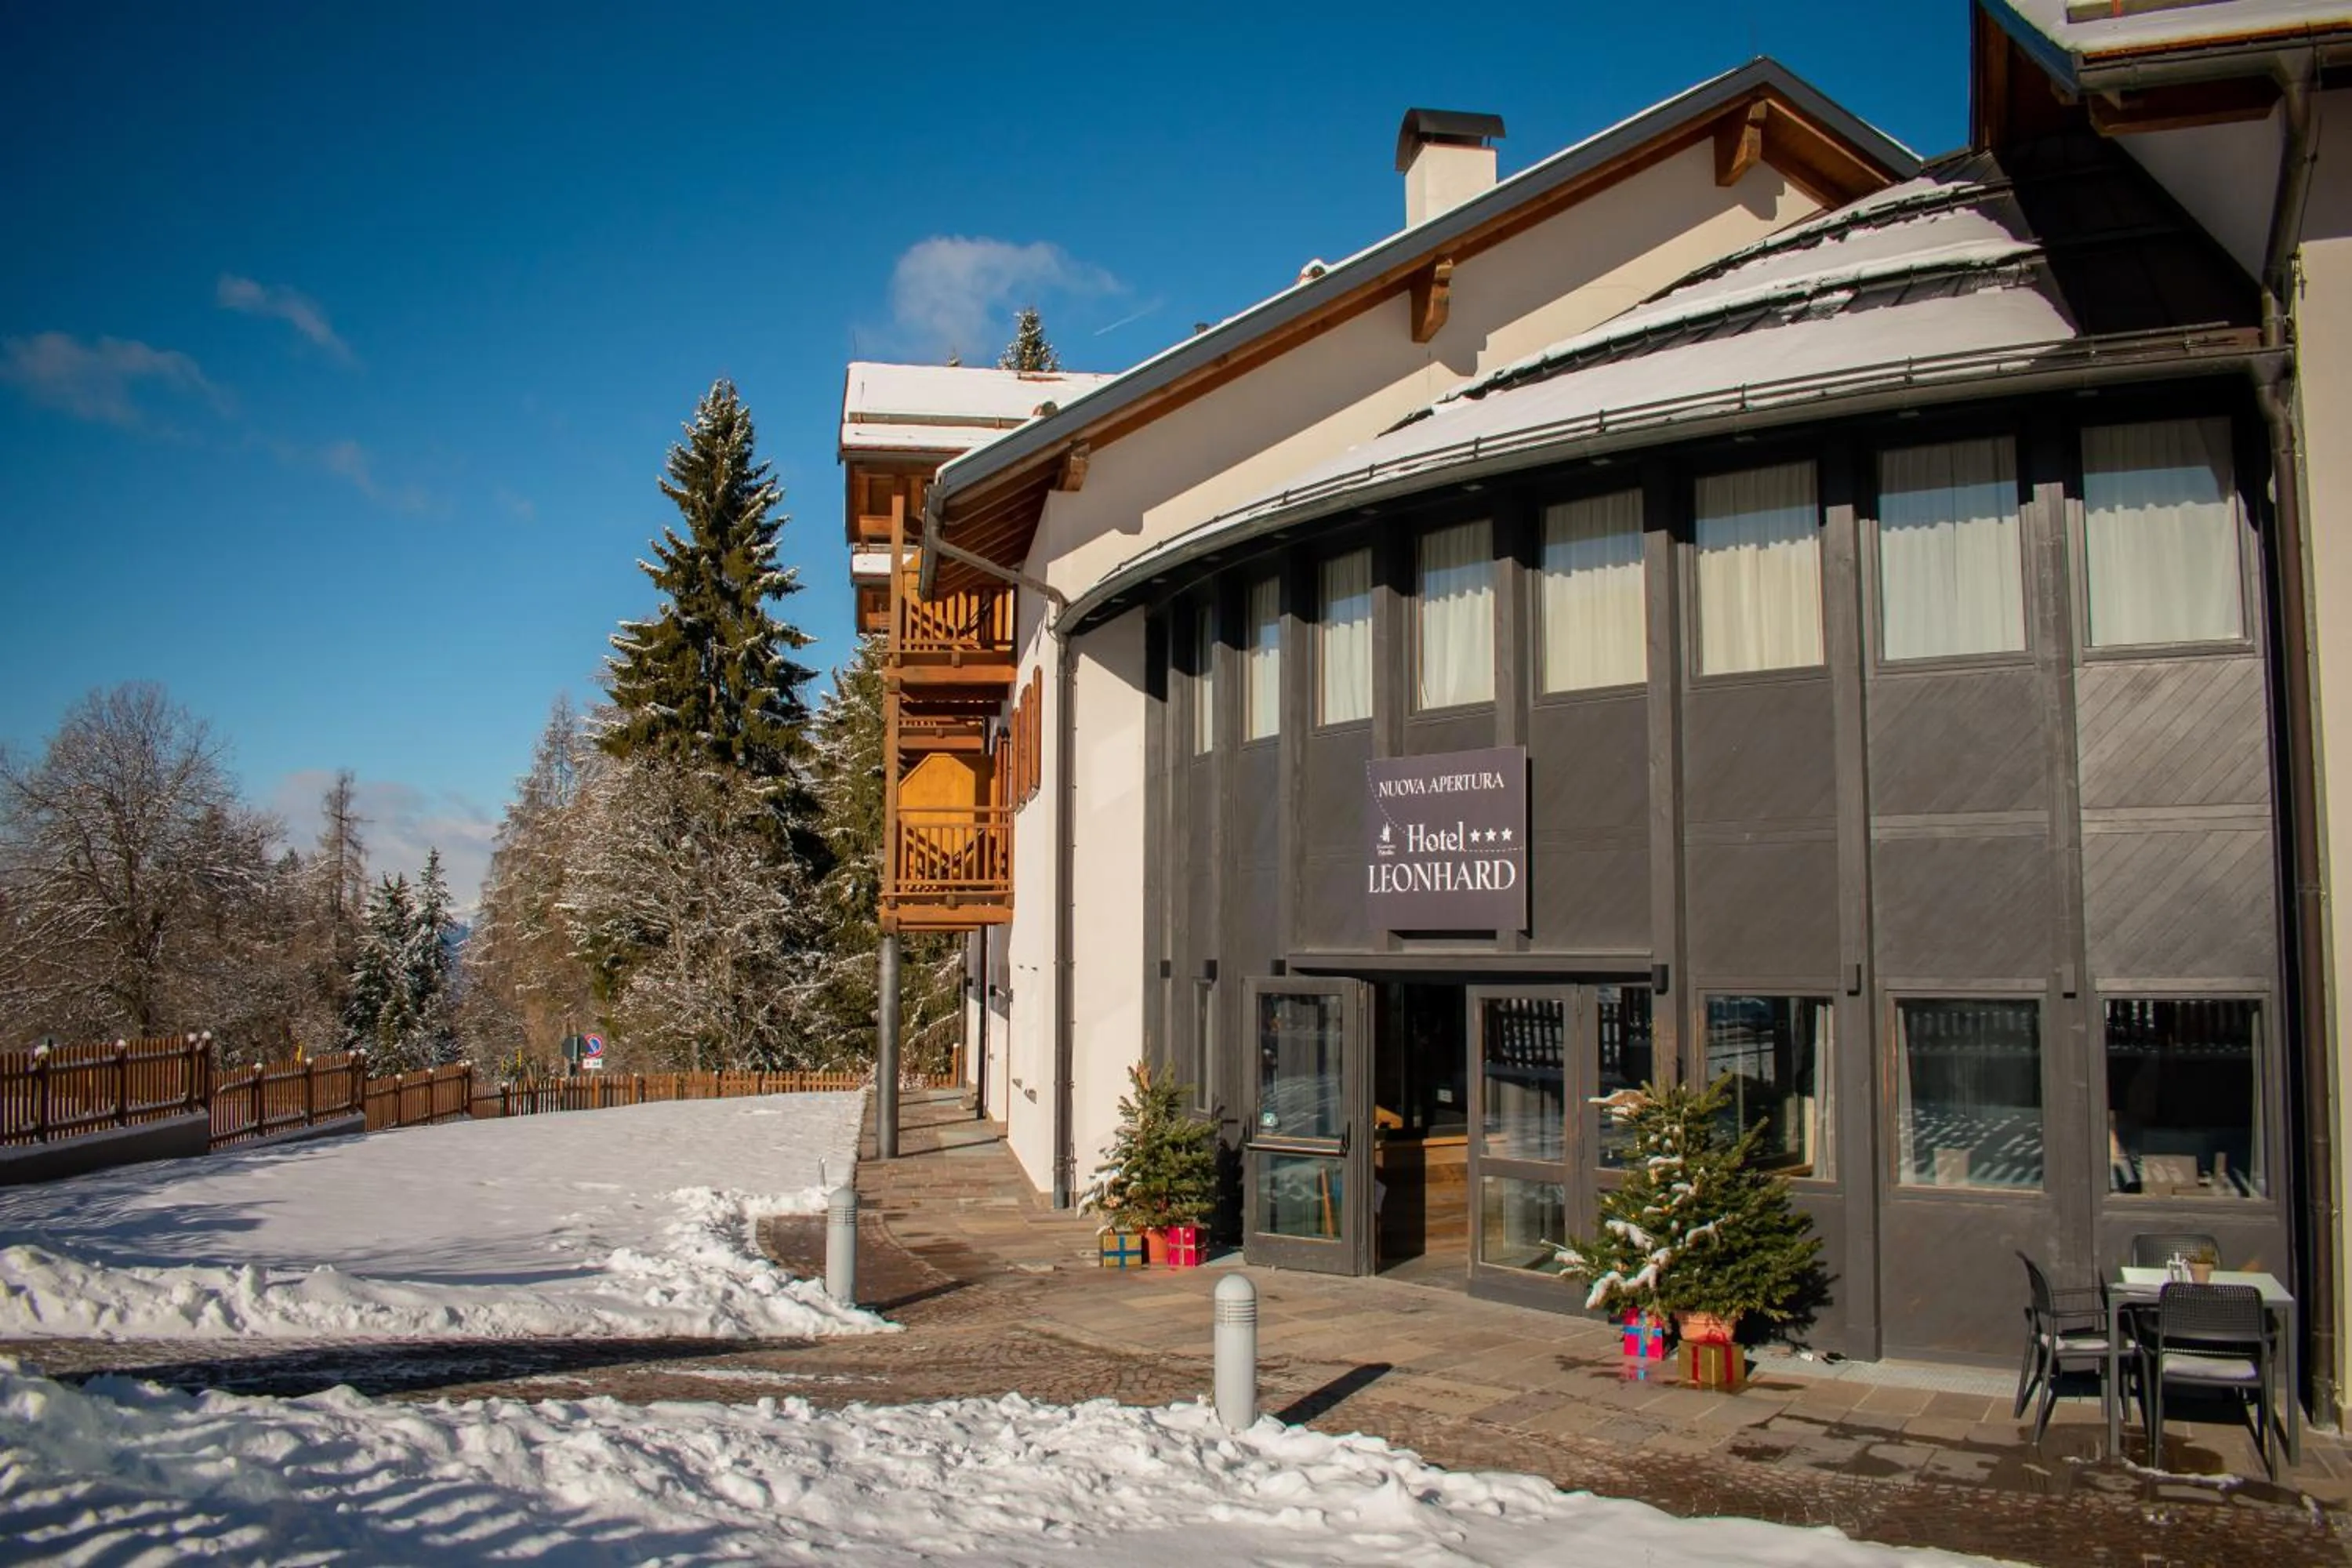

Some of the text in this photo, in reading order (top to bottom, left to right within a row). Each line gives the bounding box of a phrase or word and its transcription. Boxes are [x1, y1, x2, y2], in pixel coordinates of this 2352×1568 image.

[1378, 771, 1504, 797] NUOVA APERTURA
[1407, 821, 1465, 853] Hotel
[1368, 859, 1516, 893] LEONHARD
